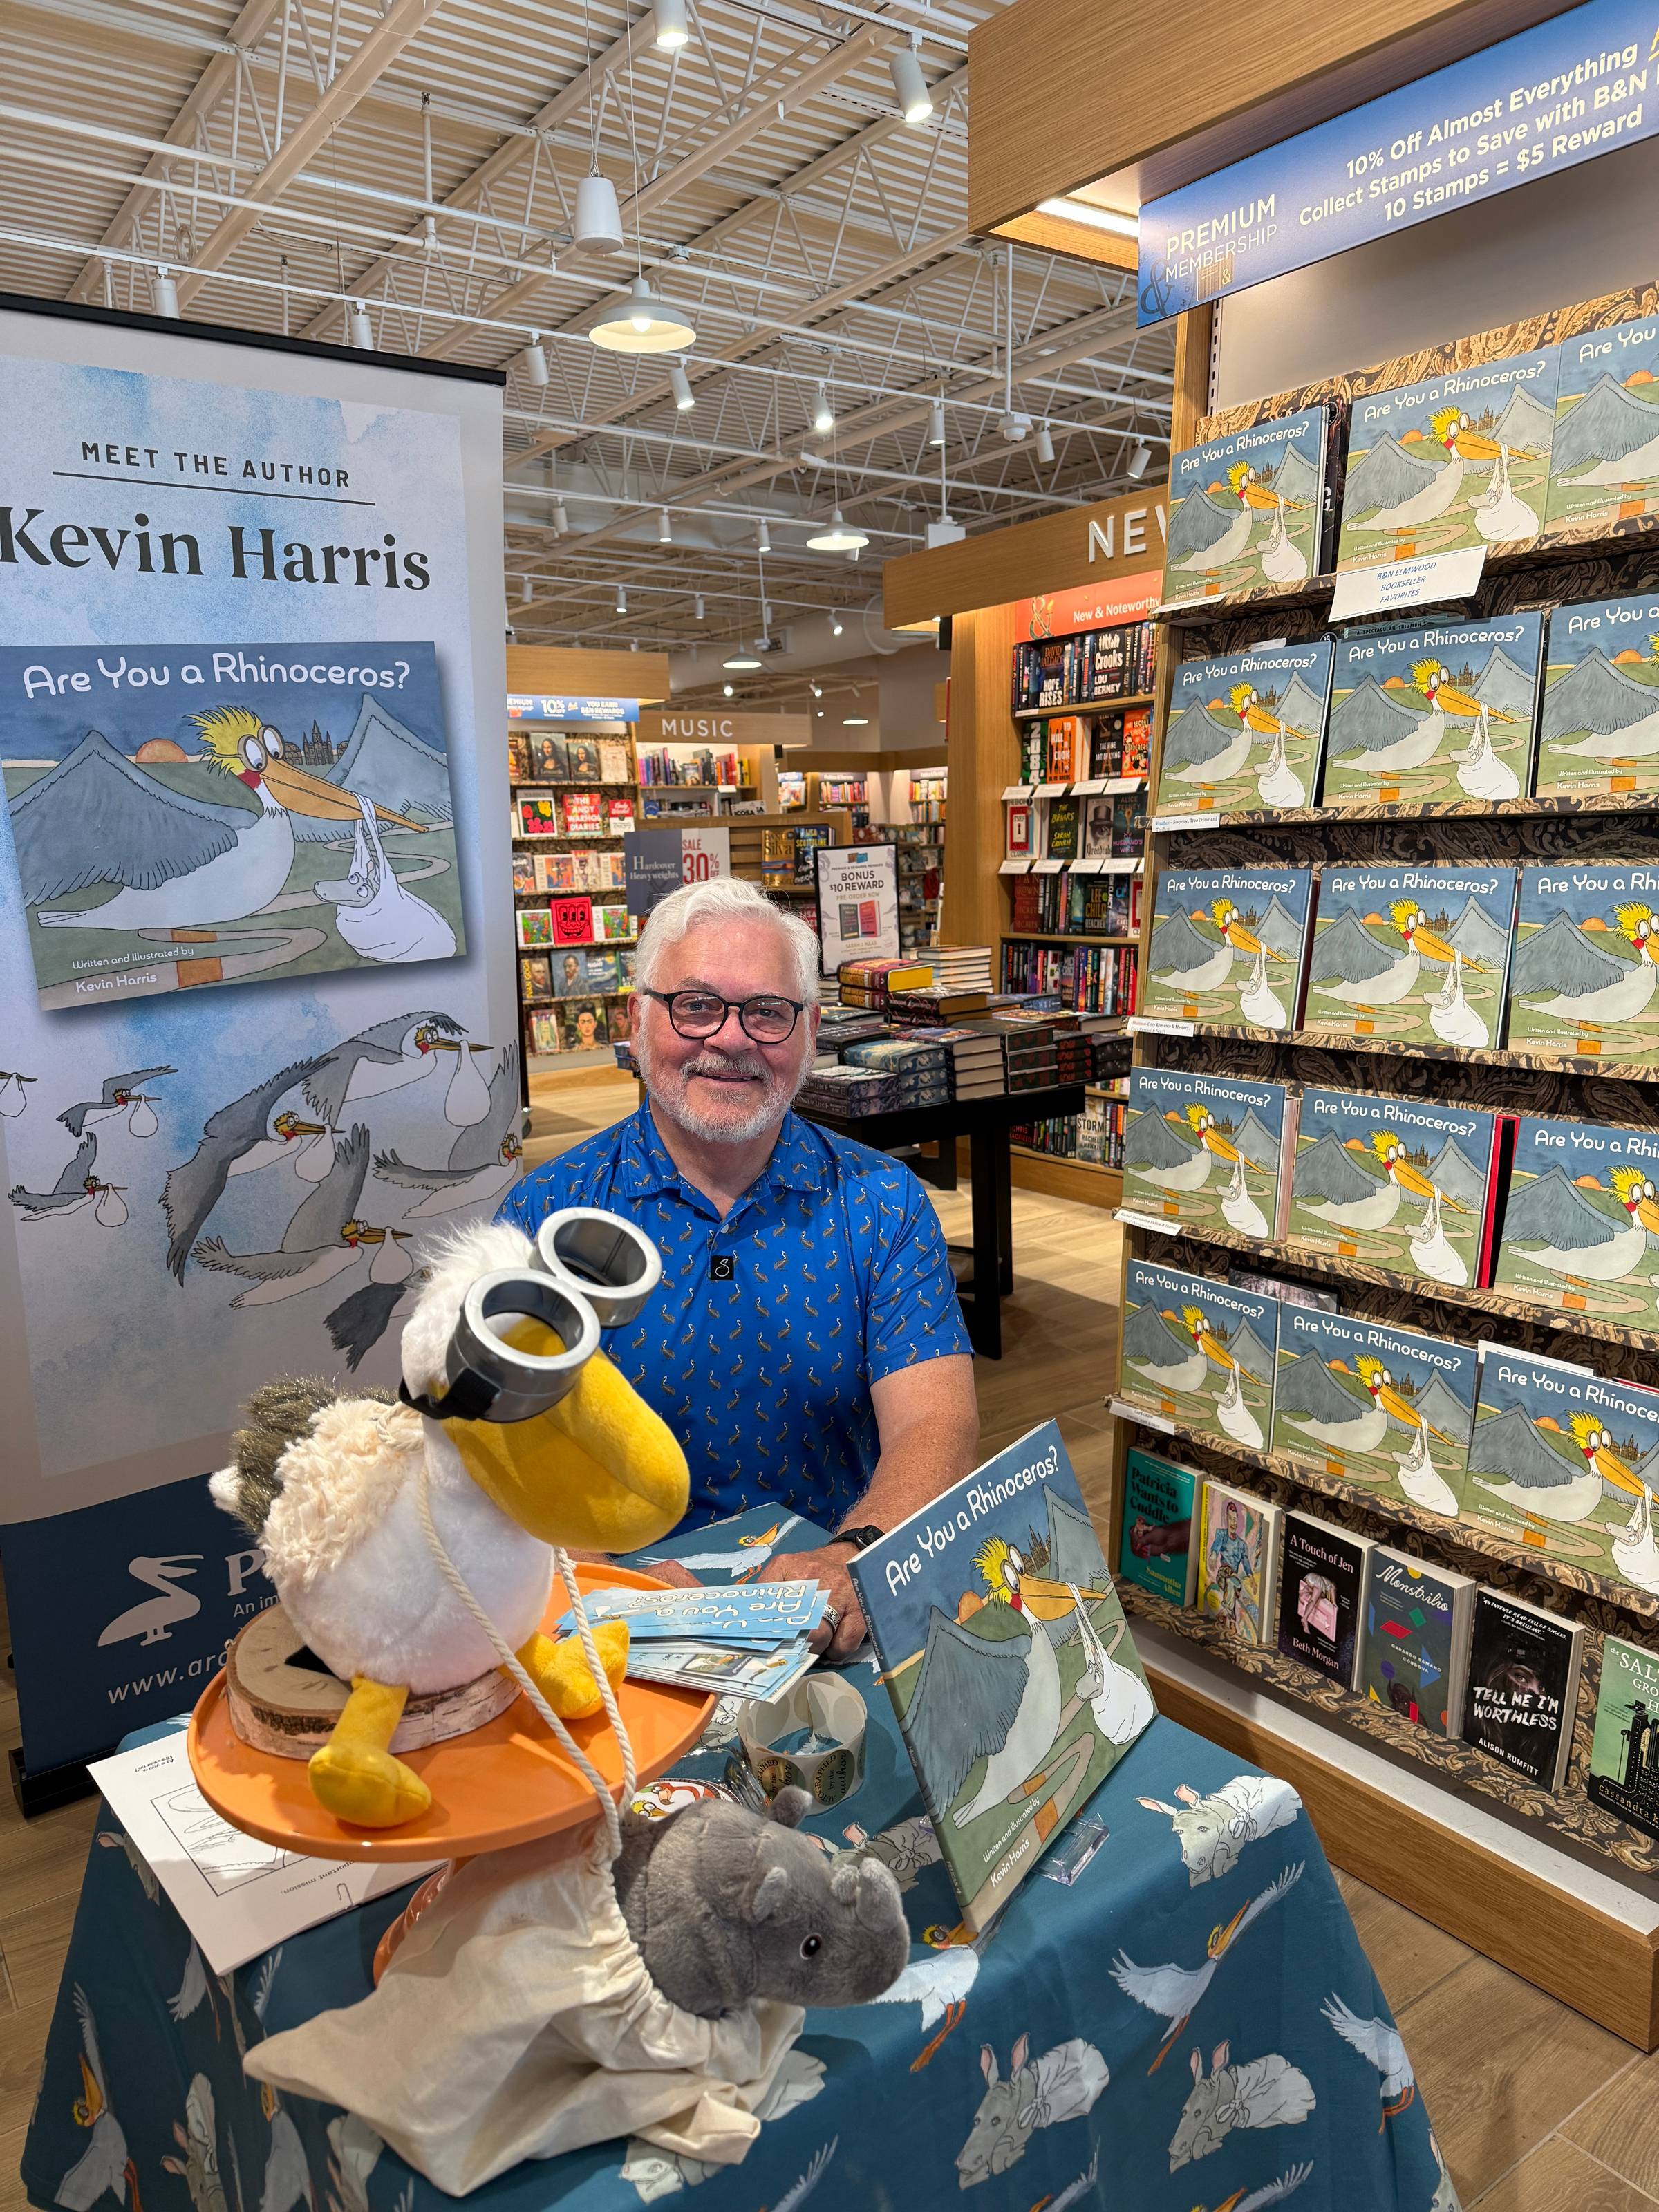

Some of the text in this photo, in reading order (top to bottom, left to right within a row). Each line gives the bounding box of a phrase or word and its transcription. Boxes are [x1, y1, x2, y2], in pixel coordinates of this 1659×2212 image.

[1346, 44, 1638, 179] 10% Off Almost Everything
[1299, 69, 1647, 226] Collect Stamps to Save with B&N
[1384, 199, 1406, 221] 10
[1412, 167, 1490, 209] Stamps
[1515, 145, 1545, 174] $5
[1551, 103, 1643, 158] Reward
[1165, 194, 1276, 261] PREMIUM
[1165, 223, 1278, 283] MEMBERSHIP
[1578, 326, 1656, 363] Are You
[1364, 360, 1546, 422] Are You a Rhinoceros?
[1181, 421, 1309, 474] Are You a Rhinoceros?
[82, 441, 350, 488] MEET THE AUTHOR
[0, 506, 431, 590] Kevin Harris
[1377, 562, 1436, 580] B&N ELMWOOD
[1380, 576, 1426, 591] BOOKSELLER
[1074, 597, 1161, 623] New & Noteworthy
[1380, 589, 1421, 603] FAVORITES
[1569, 616, 1600, 634] Are
[1606, 607, 1642, 625] You
[1349, 626, 1524, 662] Are You a Rhinoceros?
[23, 652, 411, 698] Are You a Rhinoceros?
[1095, 650, 1123, 671] Crooks
[1182, 653, 1318, 686] Are You a Rhinoceros?
[1094, 675, 1107, 684] LOU
[1094, 683, 1121, 695] BERNEY
[1039, 691, 1062, 707] RISES
[662, 718, 733, 738] MUSIC
[682, 839, 702, 850] SALE
[630, 870, 679, 881] Heavyweights
[633, 856, 675, 870] Hardcover
[841, 870, 874, 881] BONUS
[830, 880, 884, 892] $10 REWARD
[1167, 874, 1295, 894] Are You a Rhinoceros?
[1331, 874, 1498, 895] Are You a Rhinoceros?
[1537, 874, 1626, 894] Are You a
[72, 946, 194, 971] Written and Illustrated by
[75, 972, 157, 993] Kevin Harris
[1138, 1076, 1271, 1107] Are You a Rhinoceros?
[1077, 1118, 1104, 1132] STORM
[1314, 1099, 1477, 1138] Are You a Rhinoceros?
[1535, 1130, 1622, 1152] Are You a
[1136, 1271, 1265, 1320] Are You a Rhinoceros?
[1293, 1315, 1461, 1373] Are You a Rhinoceros?
[1498, 1365, 1527, 1386] Are
[1530, 1371, 1566, 1394] You
[1569, 1385, 1581, 1399] a
[1130, 1481, 1179, 1514] Wants to
[1132, 1467, 1177, 1498] Patricia
[885, 1445, 1060, 1595] Are You a Rhinoceros?
[1130, 1497, 1170, 1524] Cuddle
[1290, 1534, 1298, 1546] A
[1299, 1538, 1327, 1559] Touch
[1329, 1552, 1338, 1564] of
[1338, 1557, 1353, 1573] Jen
[1145, 1566, 1182, 1589] Samantha
[1376, 1564, 1449, 1612] Monstrilio
[233, 1602, 255, 1618] An
[1293, 1638, 1311, 1655] Beth
[1312, 1647, 1339, 1669] Morgan
[1611, 1647, 1659, 1682] the SAL
[1472, 1687, 1559, 1714] TELL ME I'M
[1473, 1702, 1557, 1731] WORTHLESS
[1479, 1738, 1539, 1776] ALISON RUMFITT
[1599, 1785, 1649, 1819] cassandra
[982, 1797, 1040, 1864] Written and Illustrated by
[990, 1839, 1030, 1888] Kevin Harris
[280, 1875, 316, 1895] mission.
